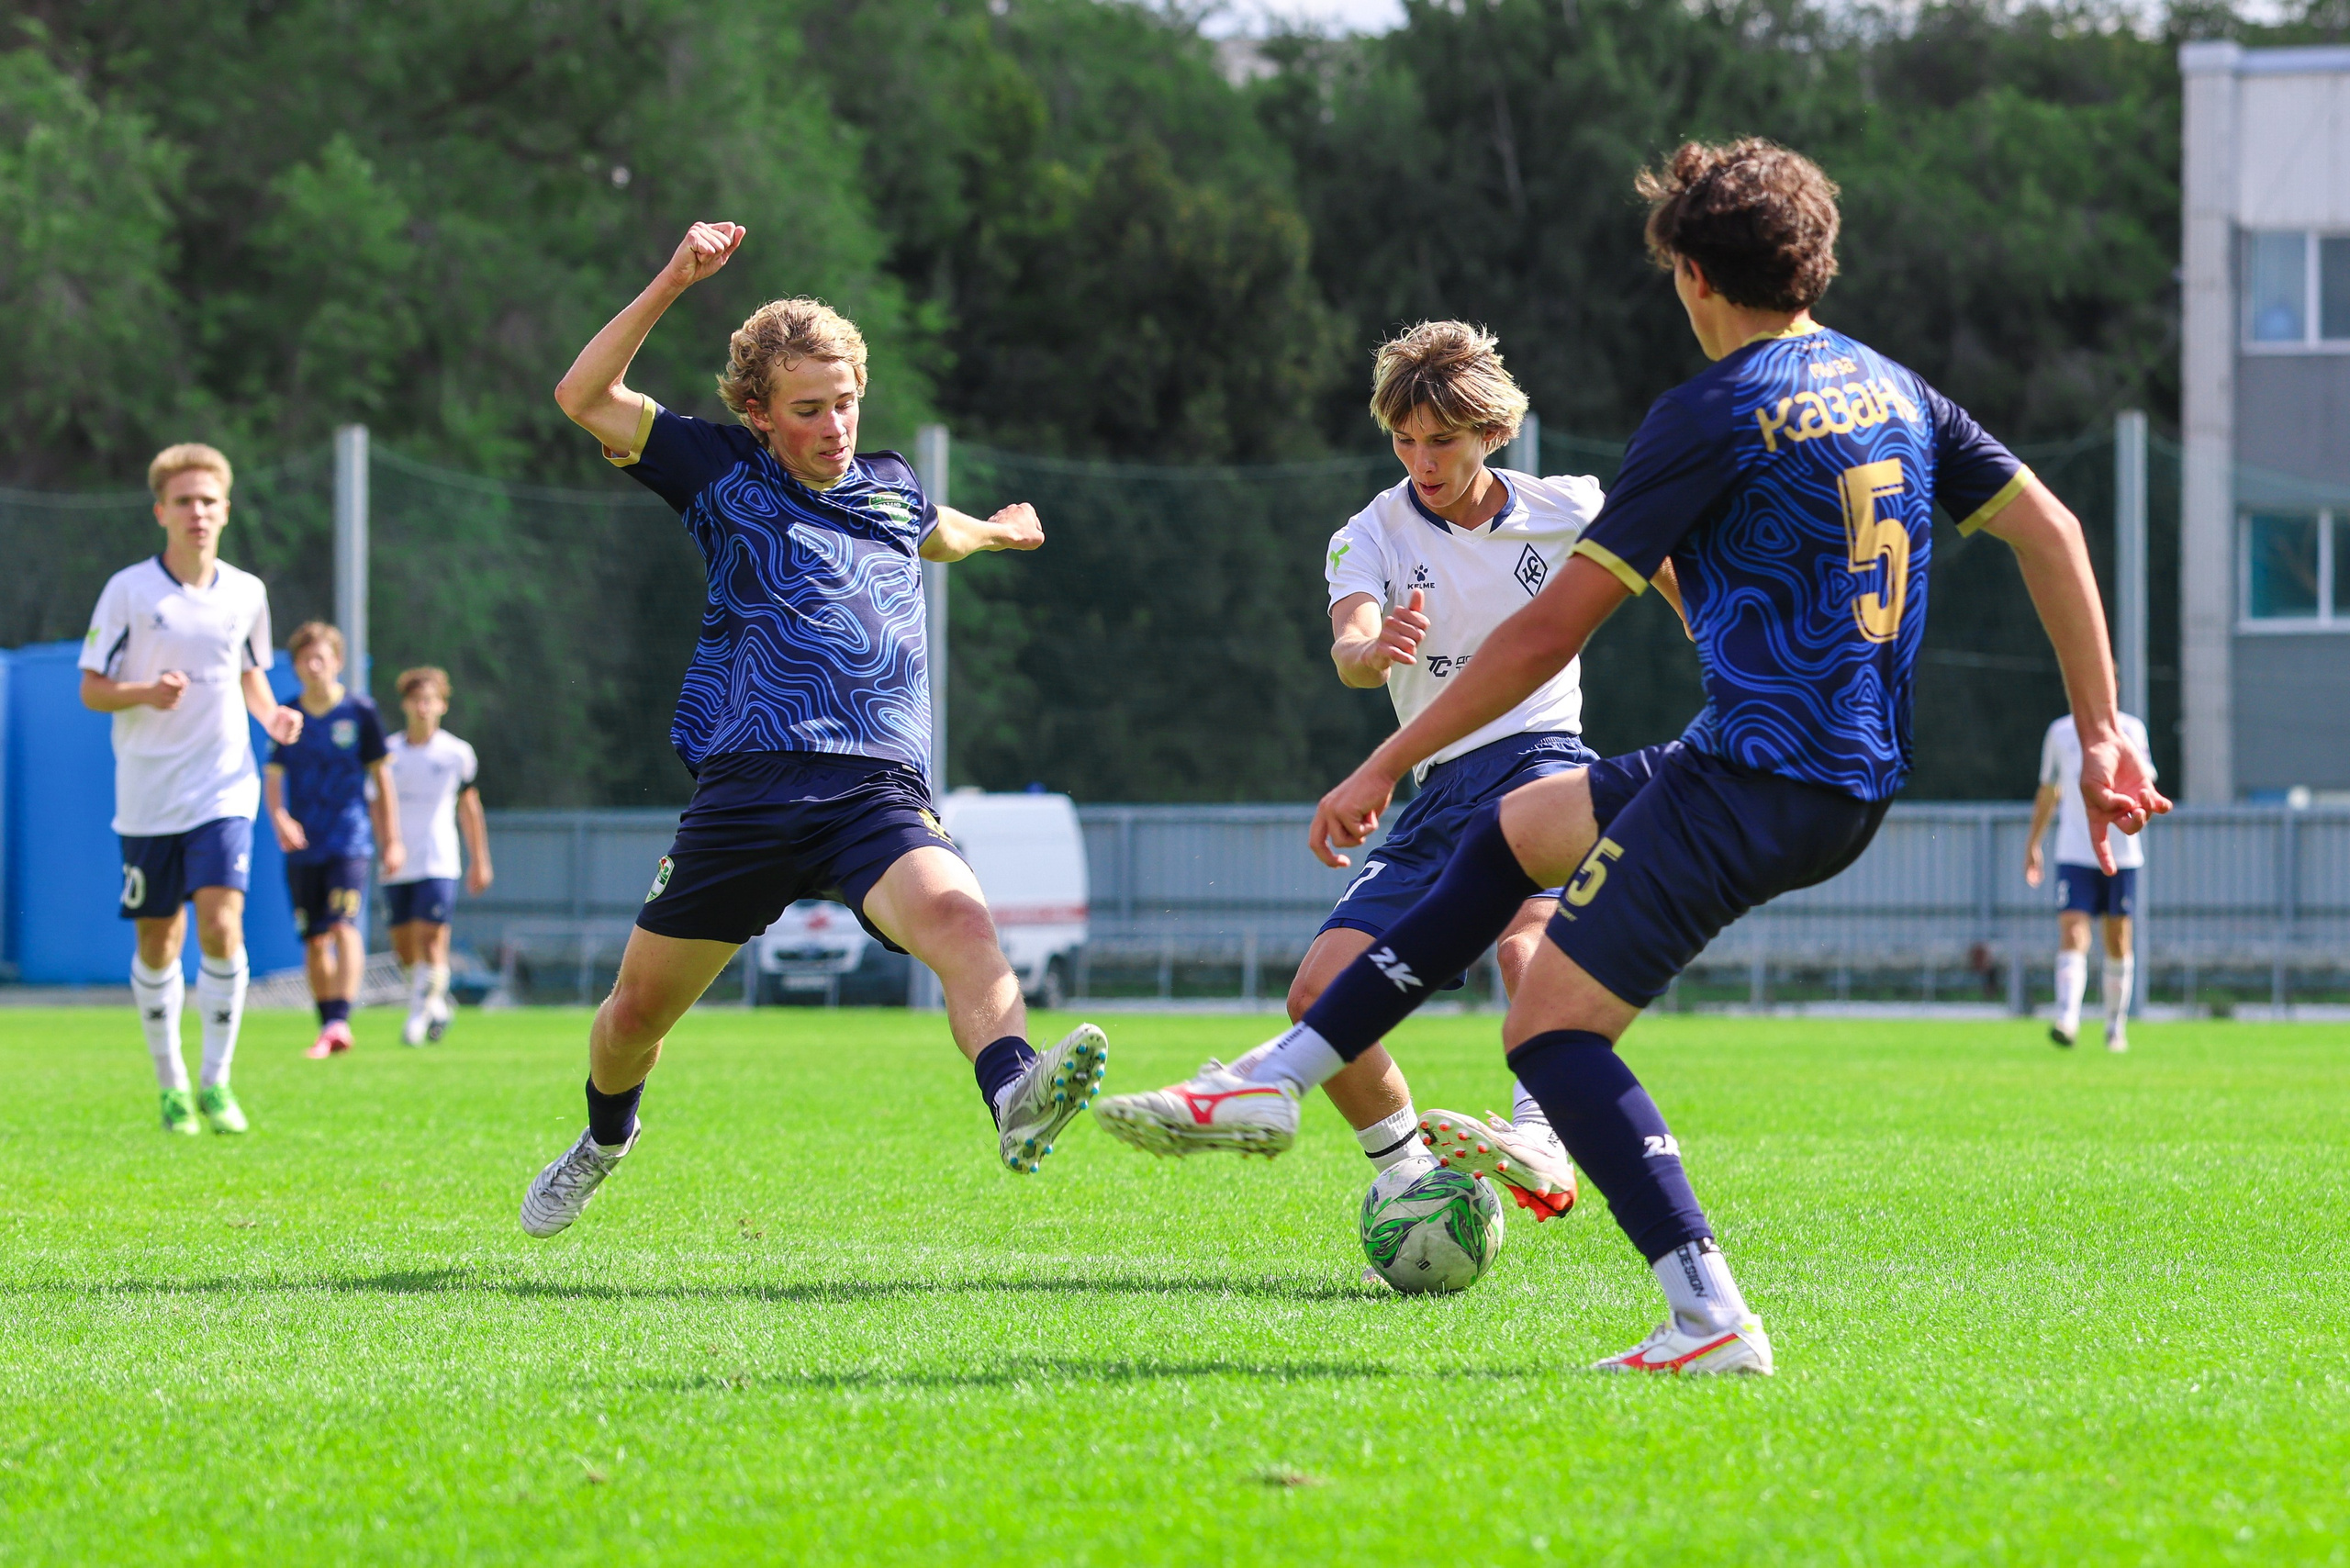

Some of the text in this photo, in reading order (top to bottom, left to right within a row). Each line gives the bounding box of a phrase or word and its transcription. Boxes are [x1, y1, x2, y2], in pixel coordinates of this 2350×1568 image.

[1837, 457, 1910, 644] 5
[1407, 582, 1436, 590] KELME
[1565, 836, 1626, 907] 5
[1368, 946, 1424, 993] 2K
[1676, 1244, 1708, 1298] DESIGN
